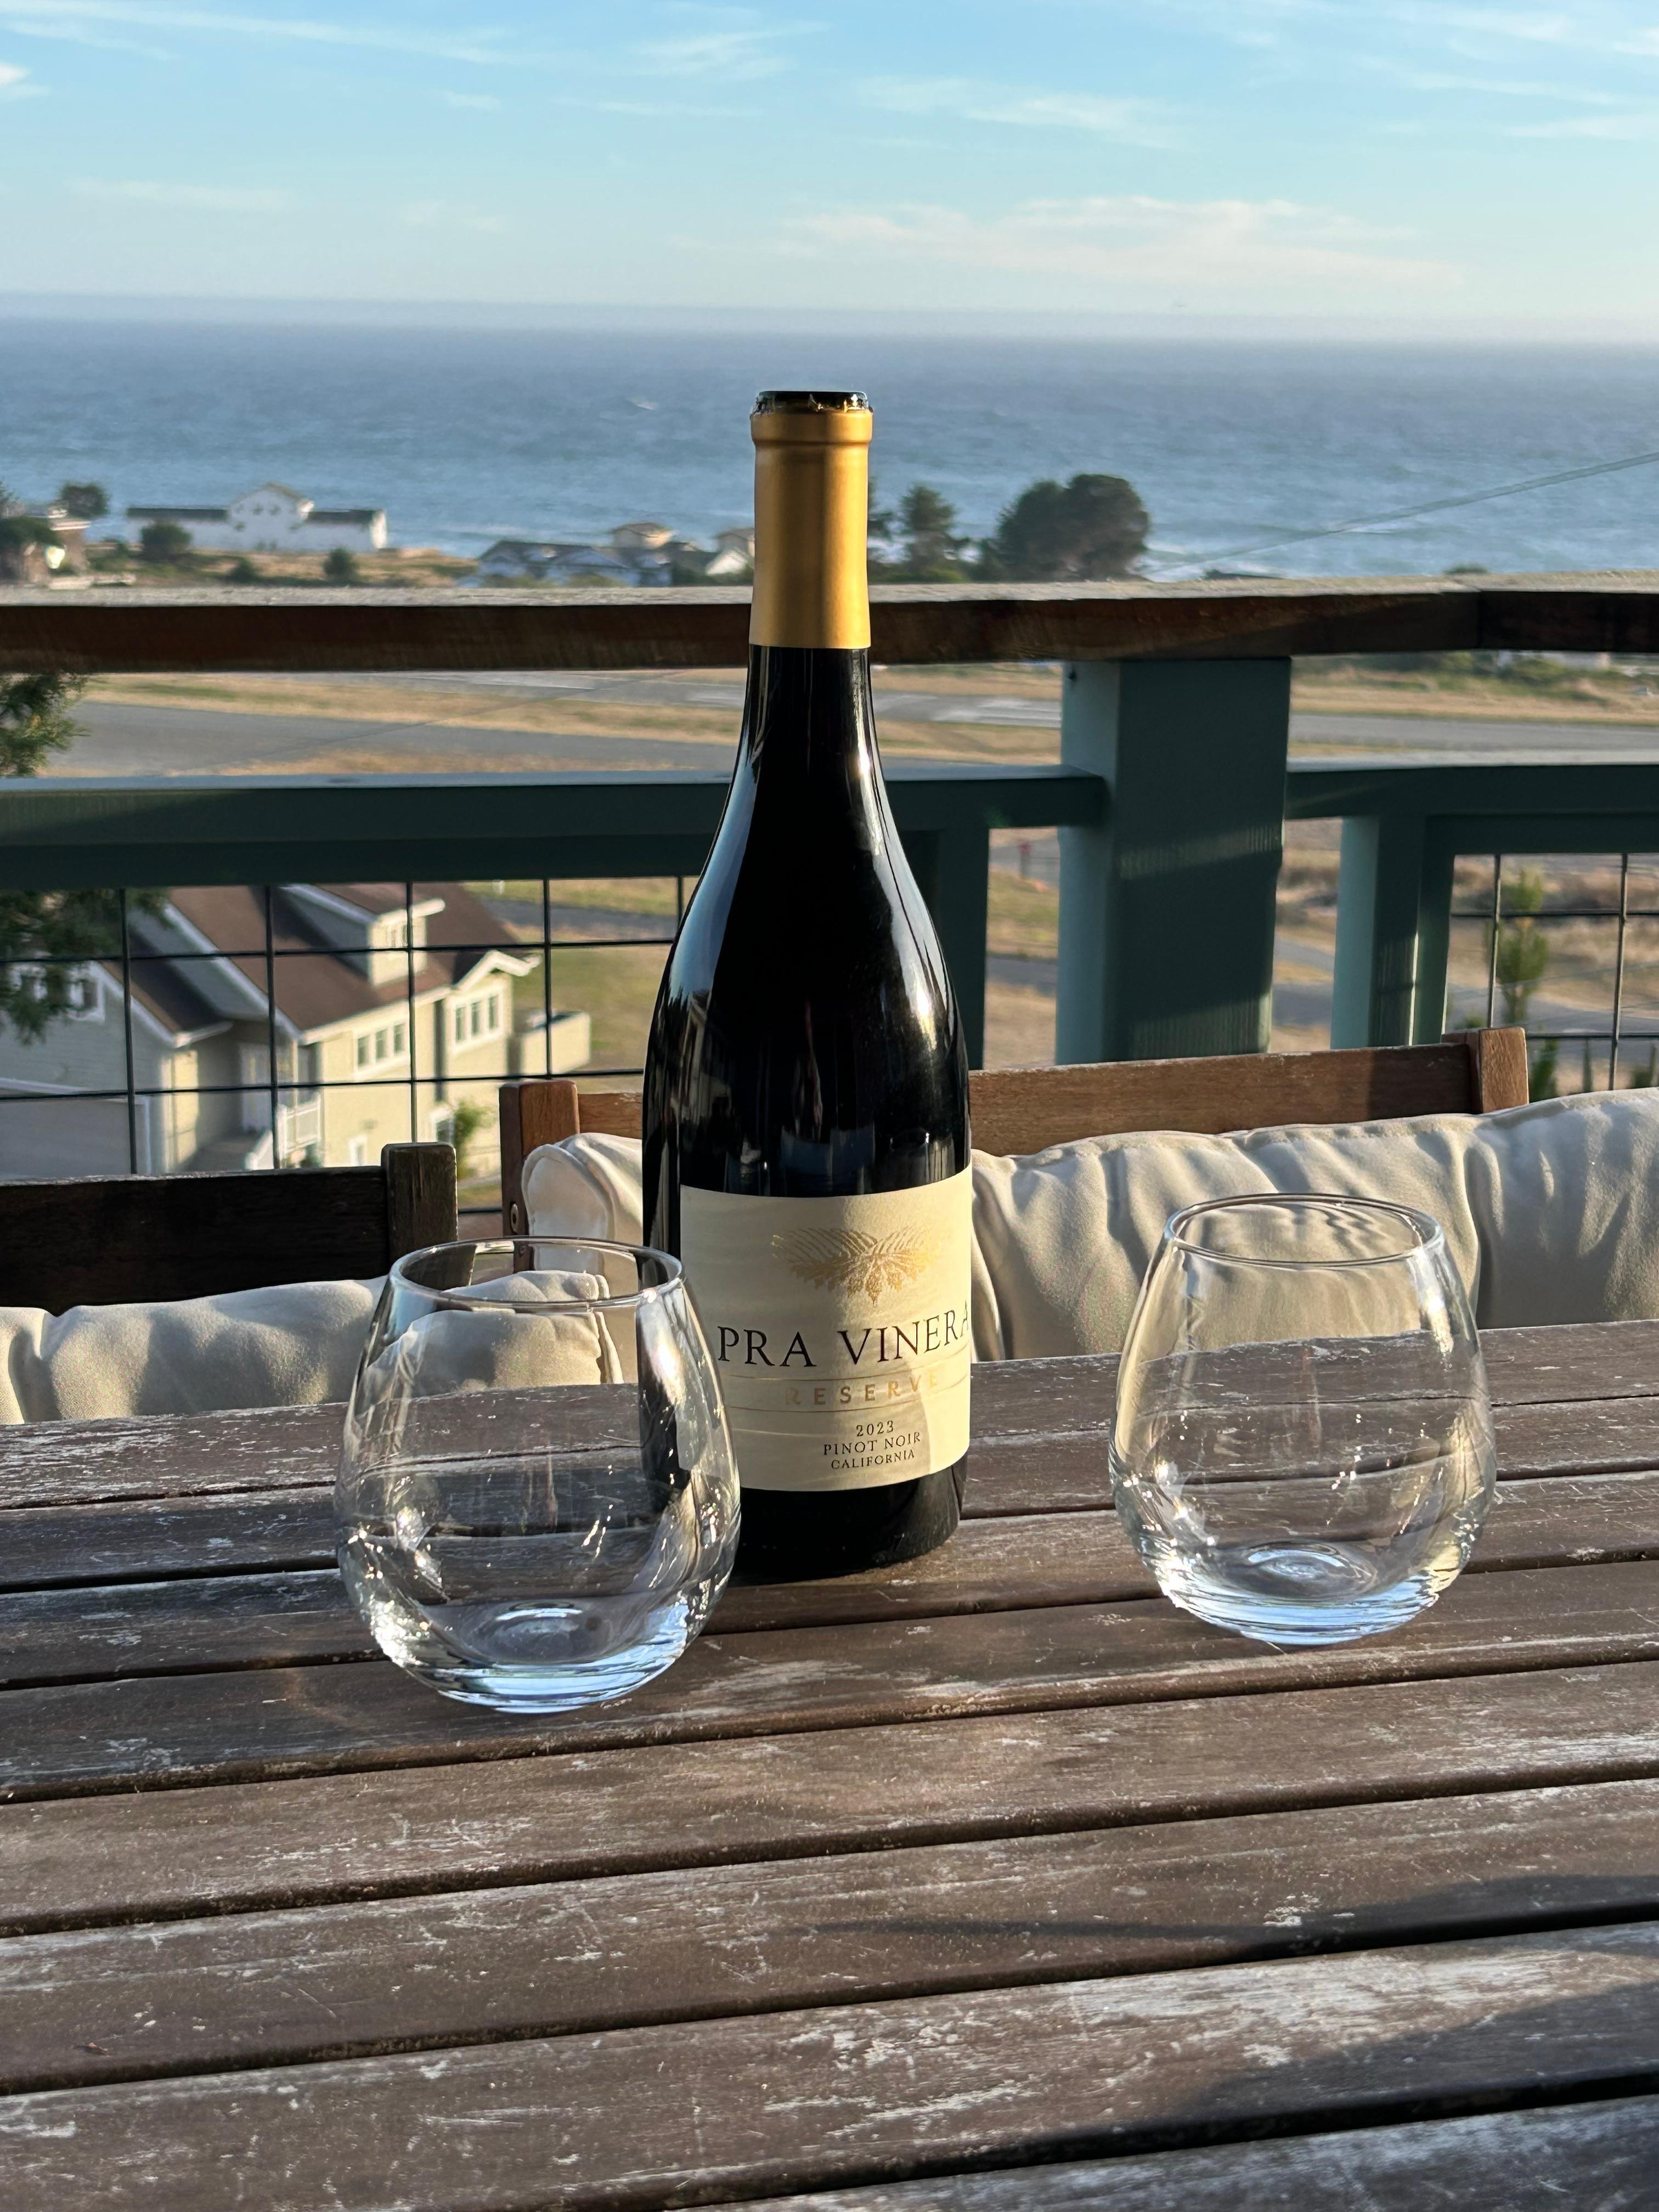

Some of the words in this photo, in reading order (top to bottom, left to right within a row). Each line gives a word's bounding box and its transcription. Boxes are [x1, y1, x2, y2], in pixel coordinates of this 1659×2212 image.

[717, 1325, 816, 1367] PRA
[785, 1370, 939, 1405] RESERVE
[856, 1420, 893, 1437] 2023
[823, 1441, 877, 1455] PINOT
[884, 1432, 921, 1449] NOIR
[831, 1449, 915, 1469] CALIFORNIA
